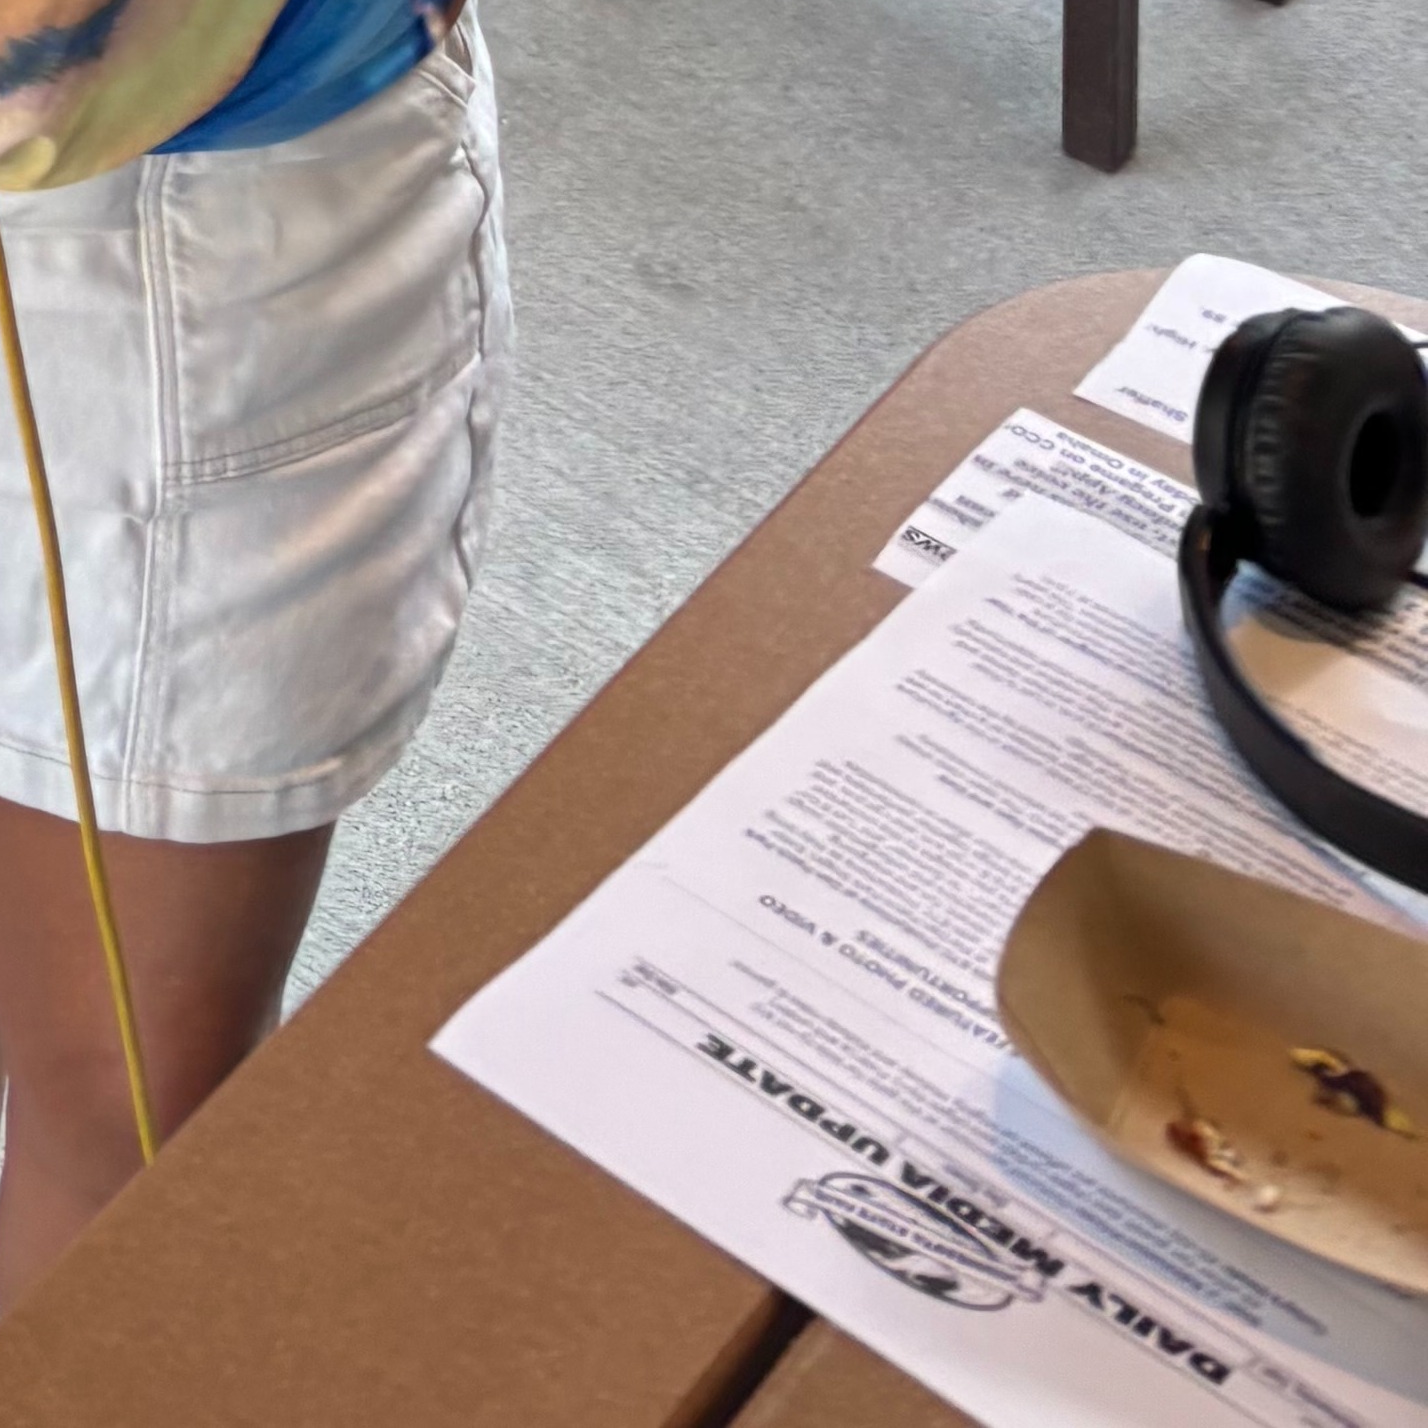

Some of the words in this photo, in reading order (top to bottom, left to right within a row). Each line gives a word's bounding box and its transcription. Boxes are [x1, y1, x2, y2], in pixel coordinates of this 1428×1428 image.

[856, 932, 1001, 1021] PPORTUNITIES
[696, 1032, 892, 1166] UPDATE
[896, 1162, 1066, 1278] MEDIA
[1071, 1280, 1233, 1387] DAILY
